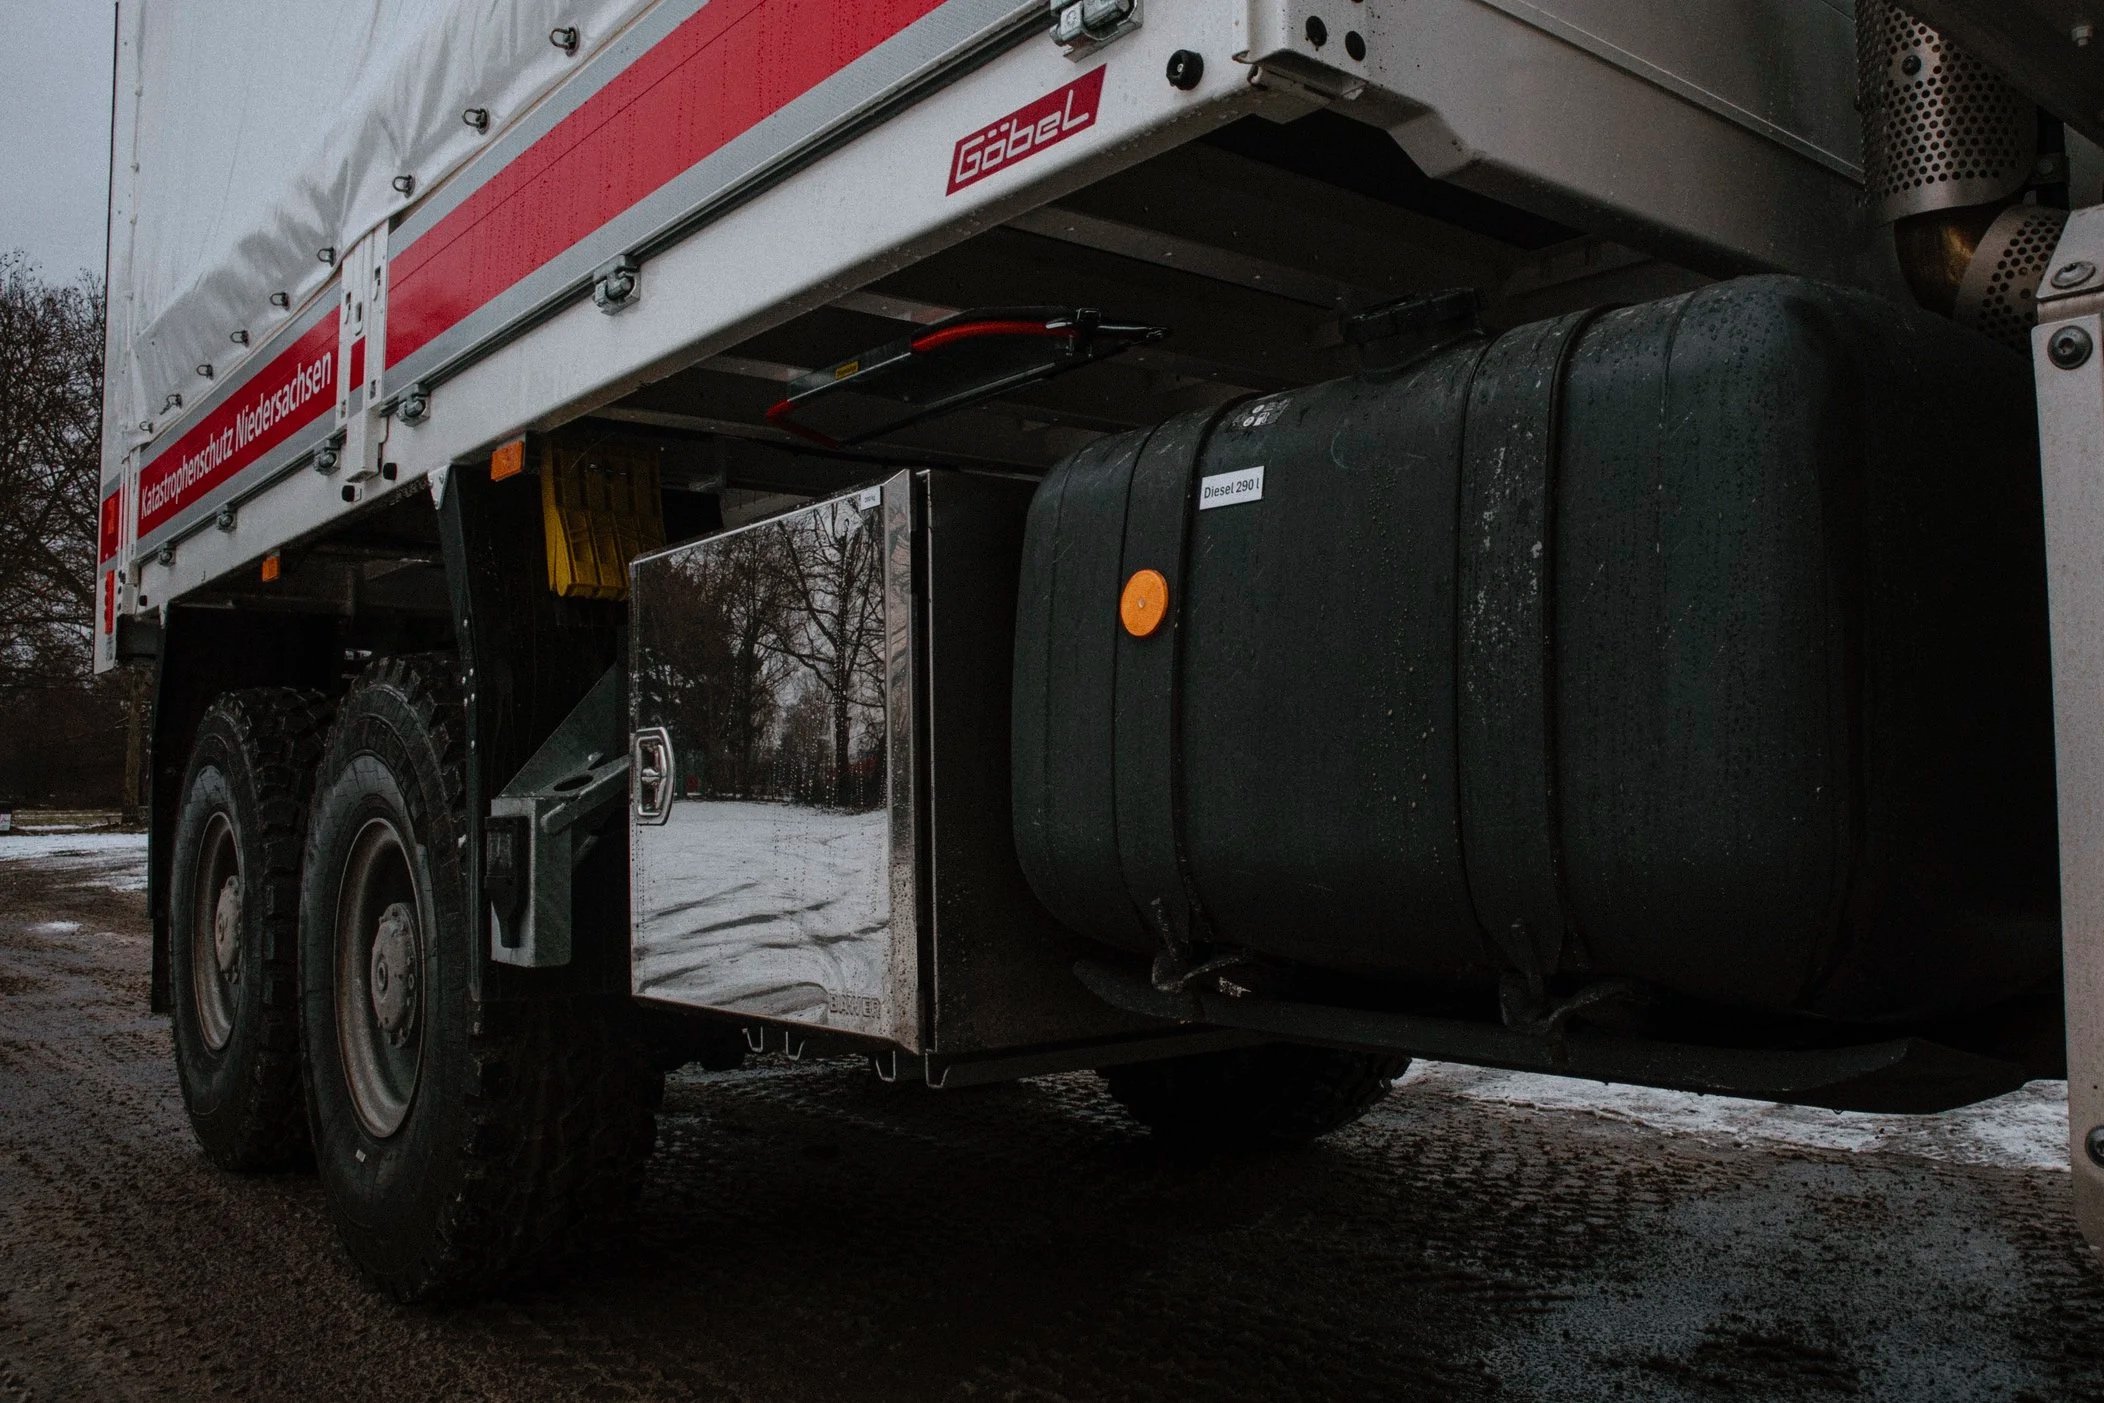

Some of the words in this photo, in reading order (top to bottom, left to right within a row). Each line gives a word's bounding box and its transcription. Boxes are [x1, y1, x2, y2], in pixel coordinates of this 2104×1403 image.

[141, 430, 234, 519] Katastrophenschutz
[235, 352, 331, 453] Niedersachsen
[1204, 482, 1234, 499] Diesel
[1236, 478, 1254, 493] 290
